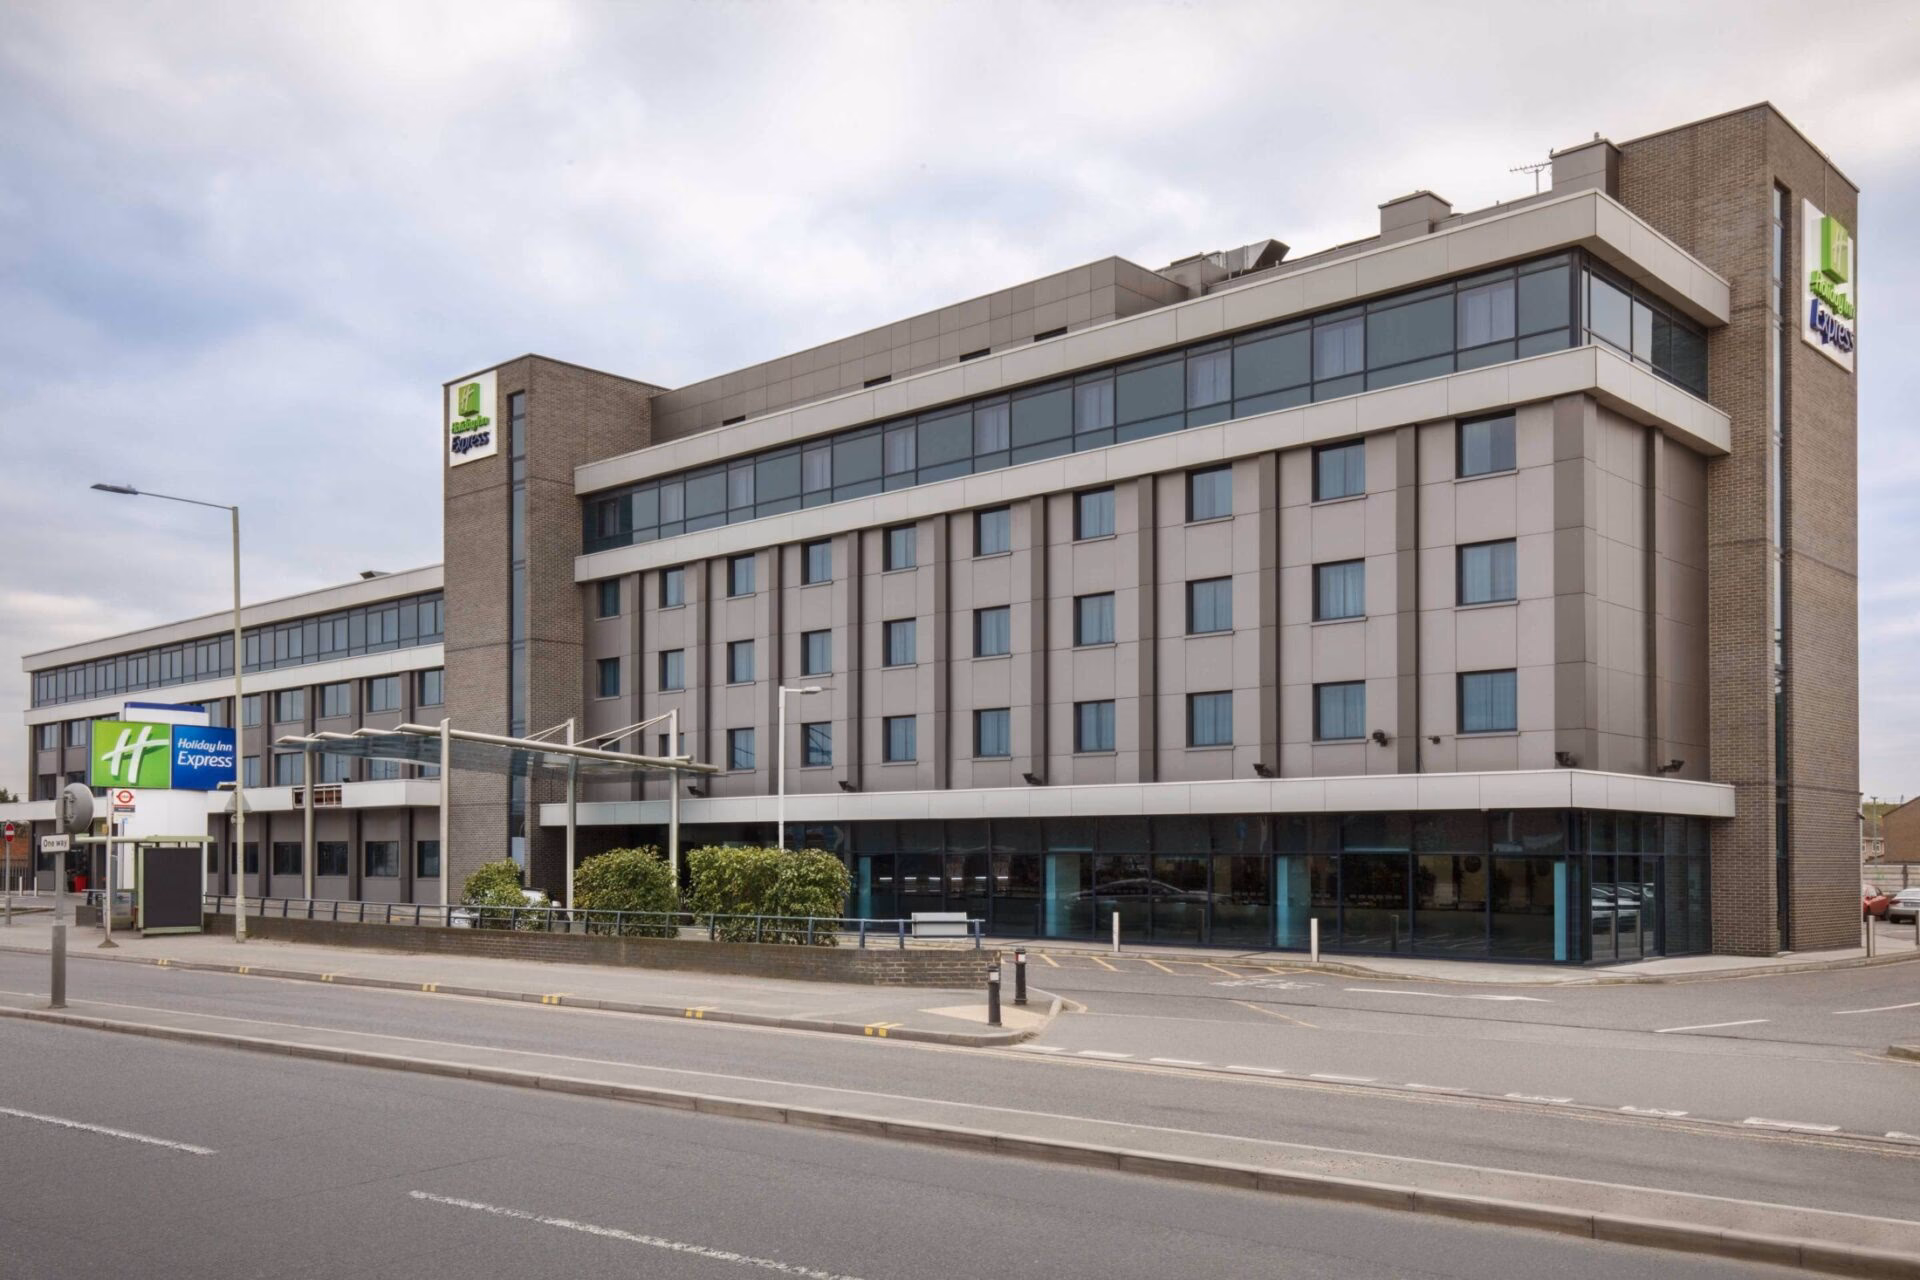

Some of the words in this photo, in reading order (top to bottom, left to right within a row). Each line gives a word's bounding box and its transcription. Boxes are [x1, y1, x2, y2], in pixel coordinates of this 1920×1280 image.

[1811, 298, 1854, 352] Express
[451, 431, 490, 454] Express
[177, 737, 216, 753] Holiday
[216, 740, 233, 751] Inn
[177, 750, 233, 769] Express
[43, 839, 55, 848] One
[56, 839, 67, 848] way
